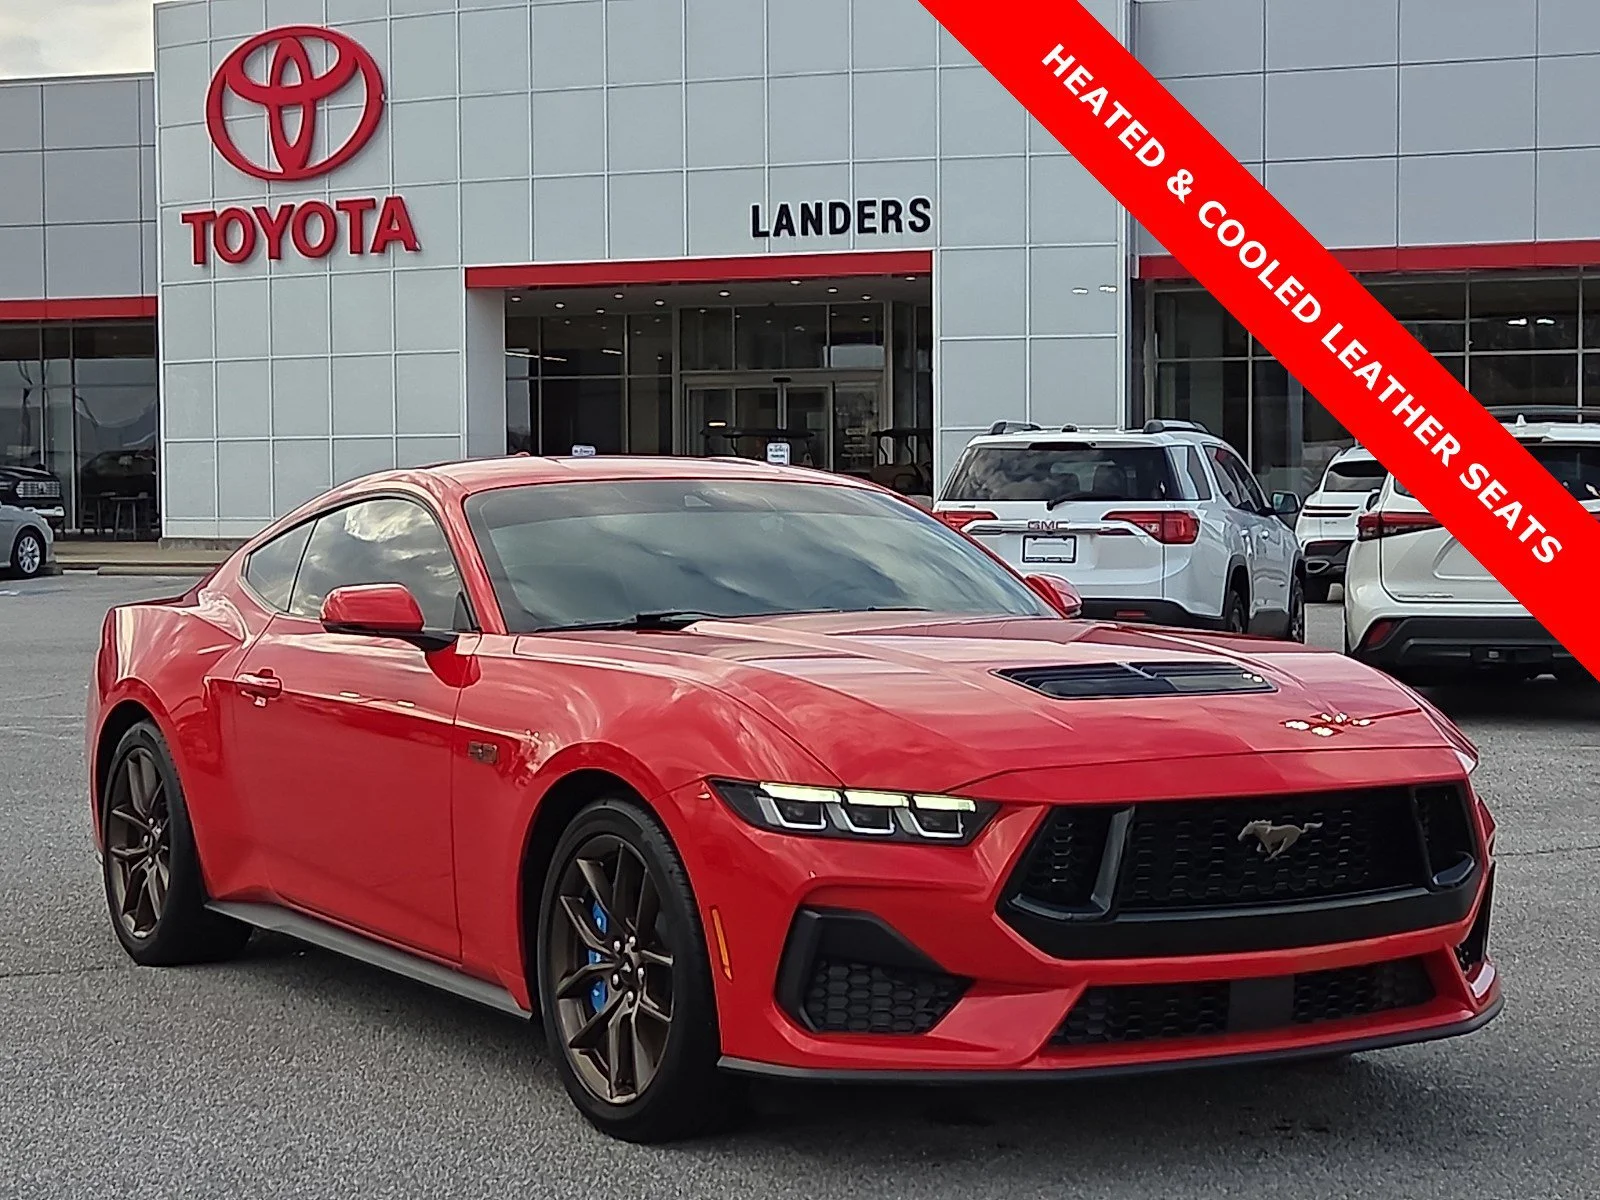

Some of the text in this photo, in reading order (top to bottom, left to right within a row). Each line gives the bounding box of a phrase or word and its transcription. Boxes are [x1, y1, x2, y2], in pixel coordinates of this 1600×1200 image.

[182, 196, 420, 264] TOYOTA
[752, 198, 931, 237] LANDERS
[1028, 520, 1069, 530] GMC
